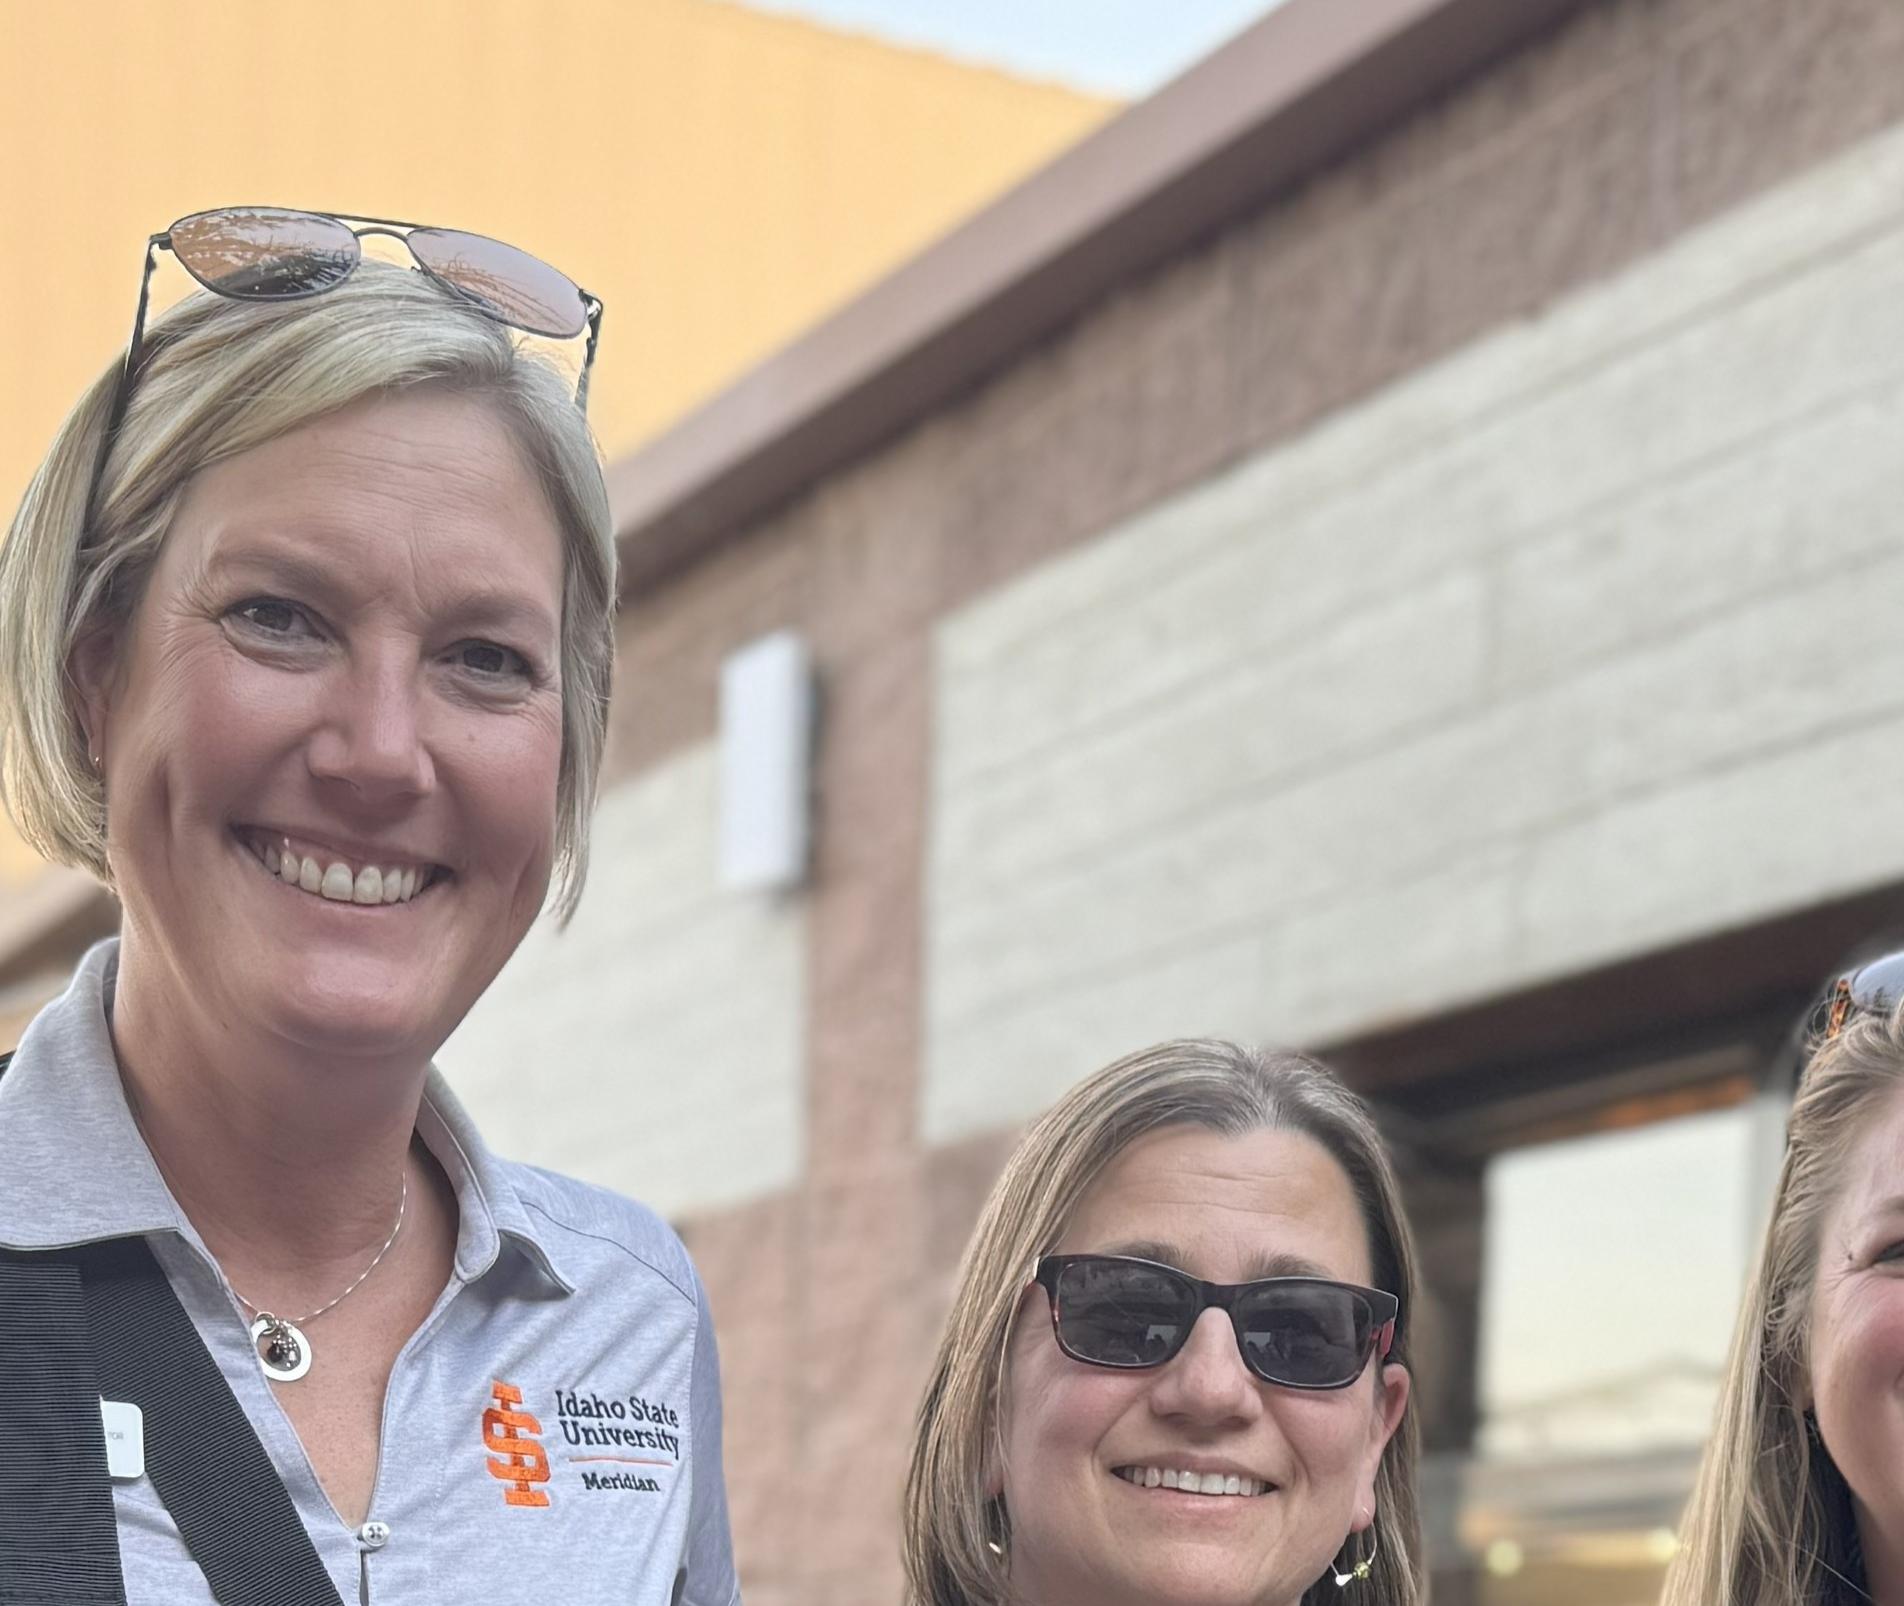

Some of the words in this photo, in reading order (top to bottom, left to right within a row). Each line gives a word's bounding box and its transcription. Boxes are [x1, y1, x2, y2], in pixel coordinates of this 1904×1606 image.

[555, 1390, 626, 1420] Idaho
[630, 1396, 679, 1428] State
[559, 1420, 680, 1460] University
[581, 1472, 661, 1492] Meridian
